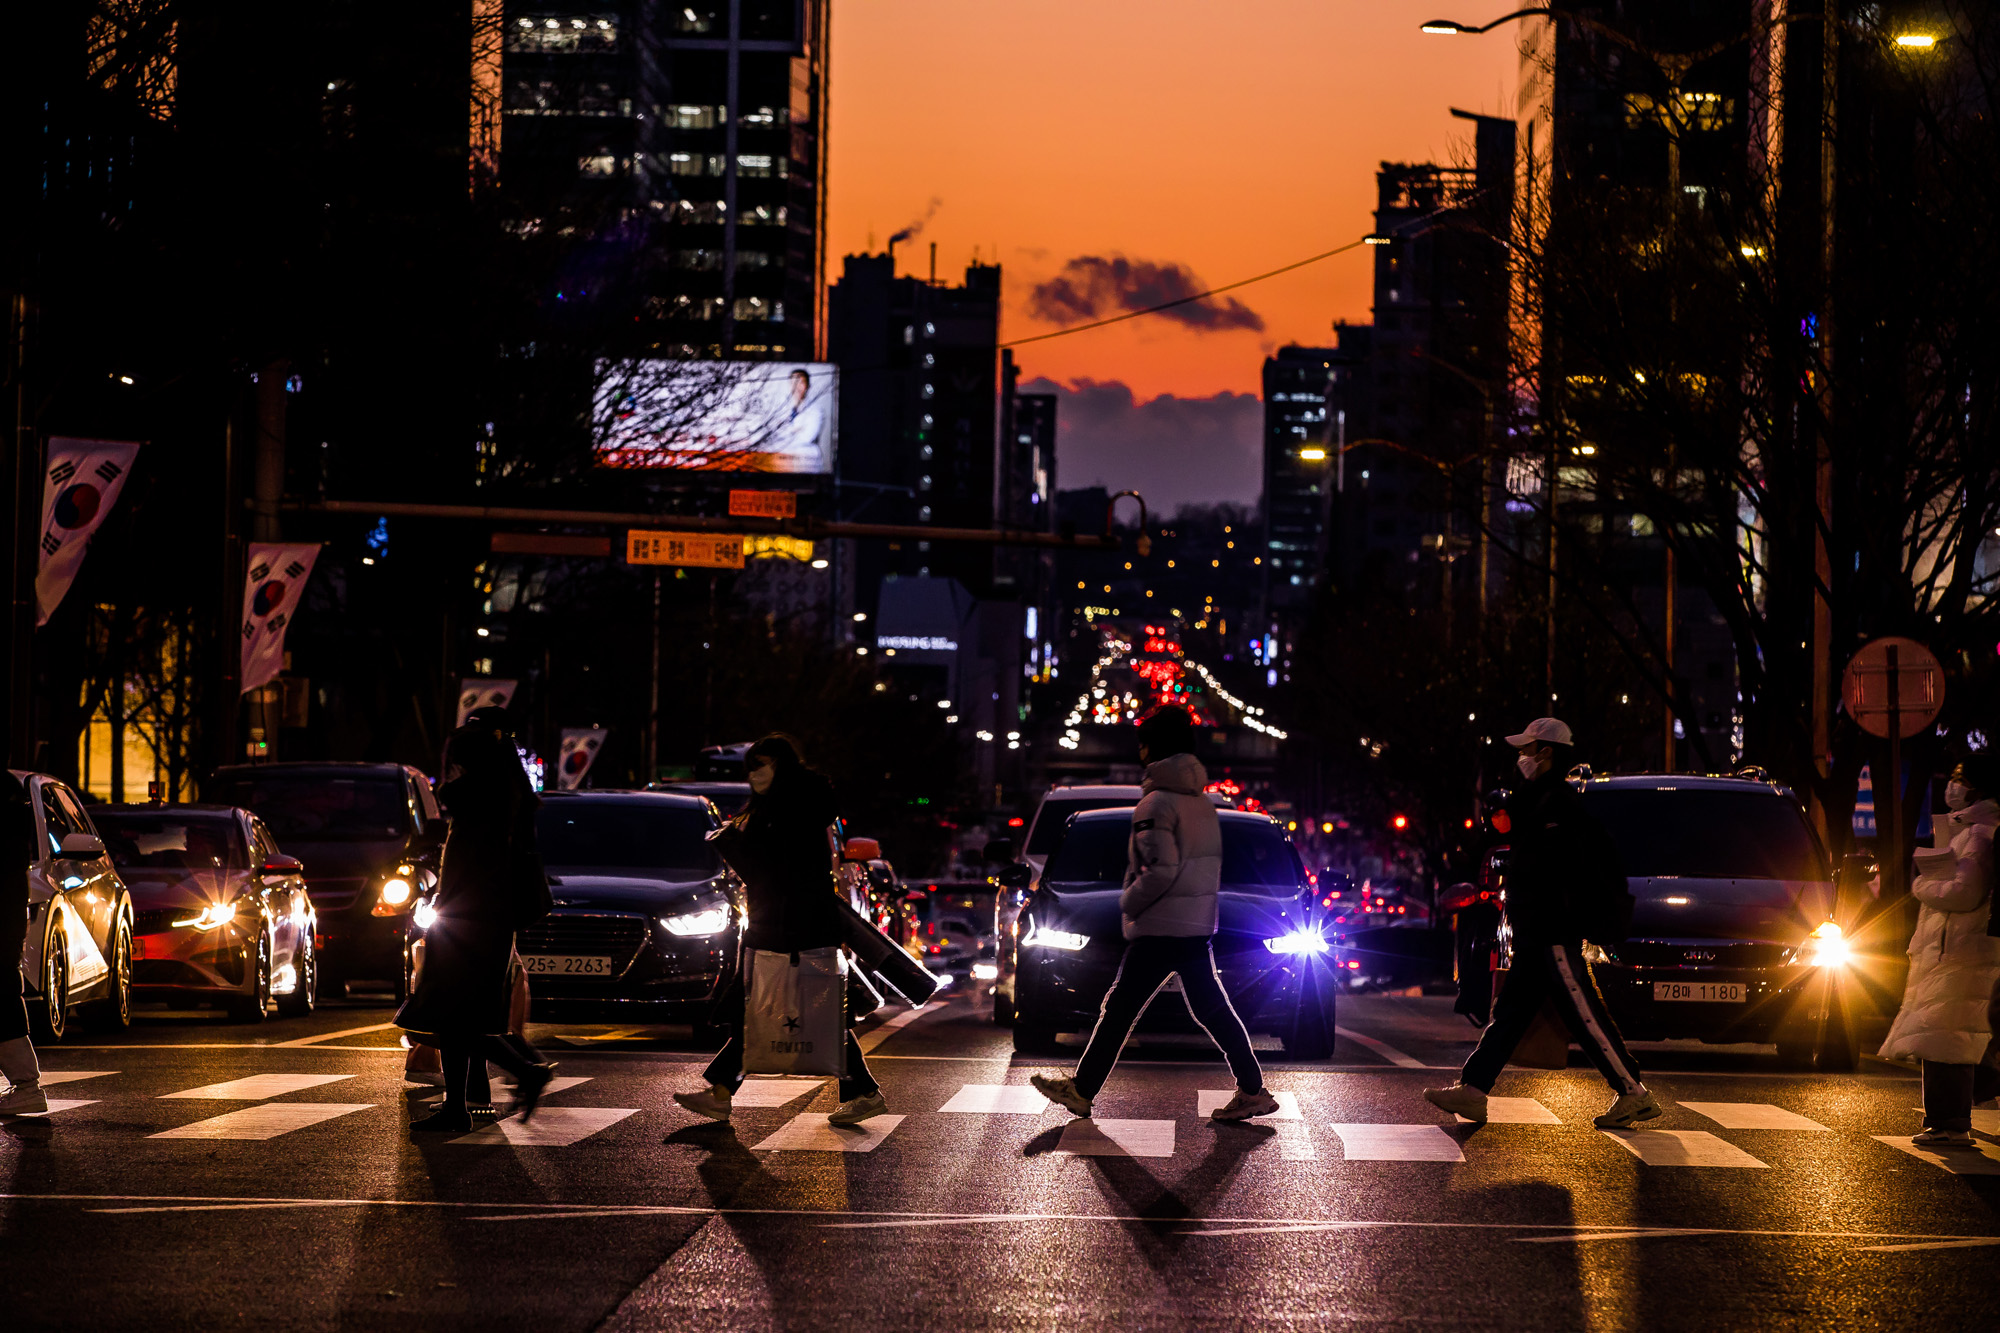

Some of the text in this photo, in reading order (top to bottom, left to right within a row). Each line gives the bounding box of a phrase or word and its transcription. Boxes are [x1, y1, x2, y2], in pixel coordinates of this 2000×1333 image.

[1688, 950, 1711, 960] KIA
[527, 957, 603, 973] 25수 2263
[1662, 984, 1738, 1000] 78마 1180
